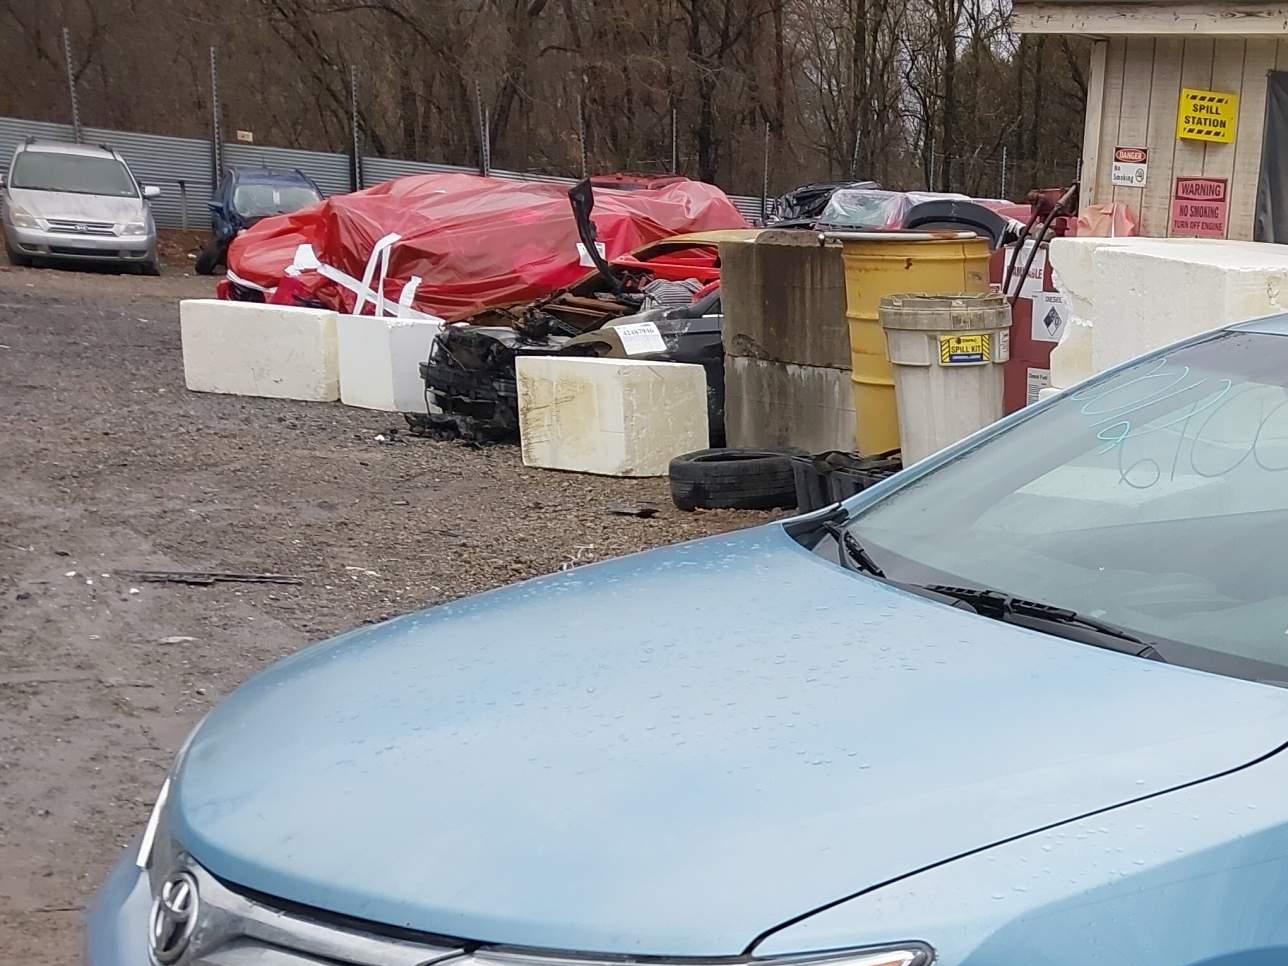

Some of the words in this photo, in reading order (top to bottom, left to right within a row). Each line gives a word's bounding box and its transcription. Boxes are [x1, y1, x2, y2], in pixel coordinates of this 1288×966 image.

[1192, 103, 1222, 115] SPILL
[1184, 115, 1227, 128] STATION
[1119, 151, 1142, 160] DANGER
[1113, 172, 1134, 183] Smoking
[1181, 182, 1222, 197] WARNING
[1179, 204, 1188, 217] NO
[1189, 205, 1219, 219] SMOKING
[1174, 219, 1188, 229] TURN
[1190, 220, 1201, 230] OFF
[1201, 222, 1223, 231] ENGINE
[951, 345, 970, 353] SPILL
